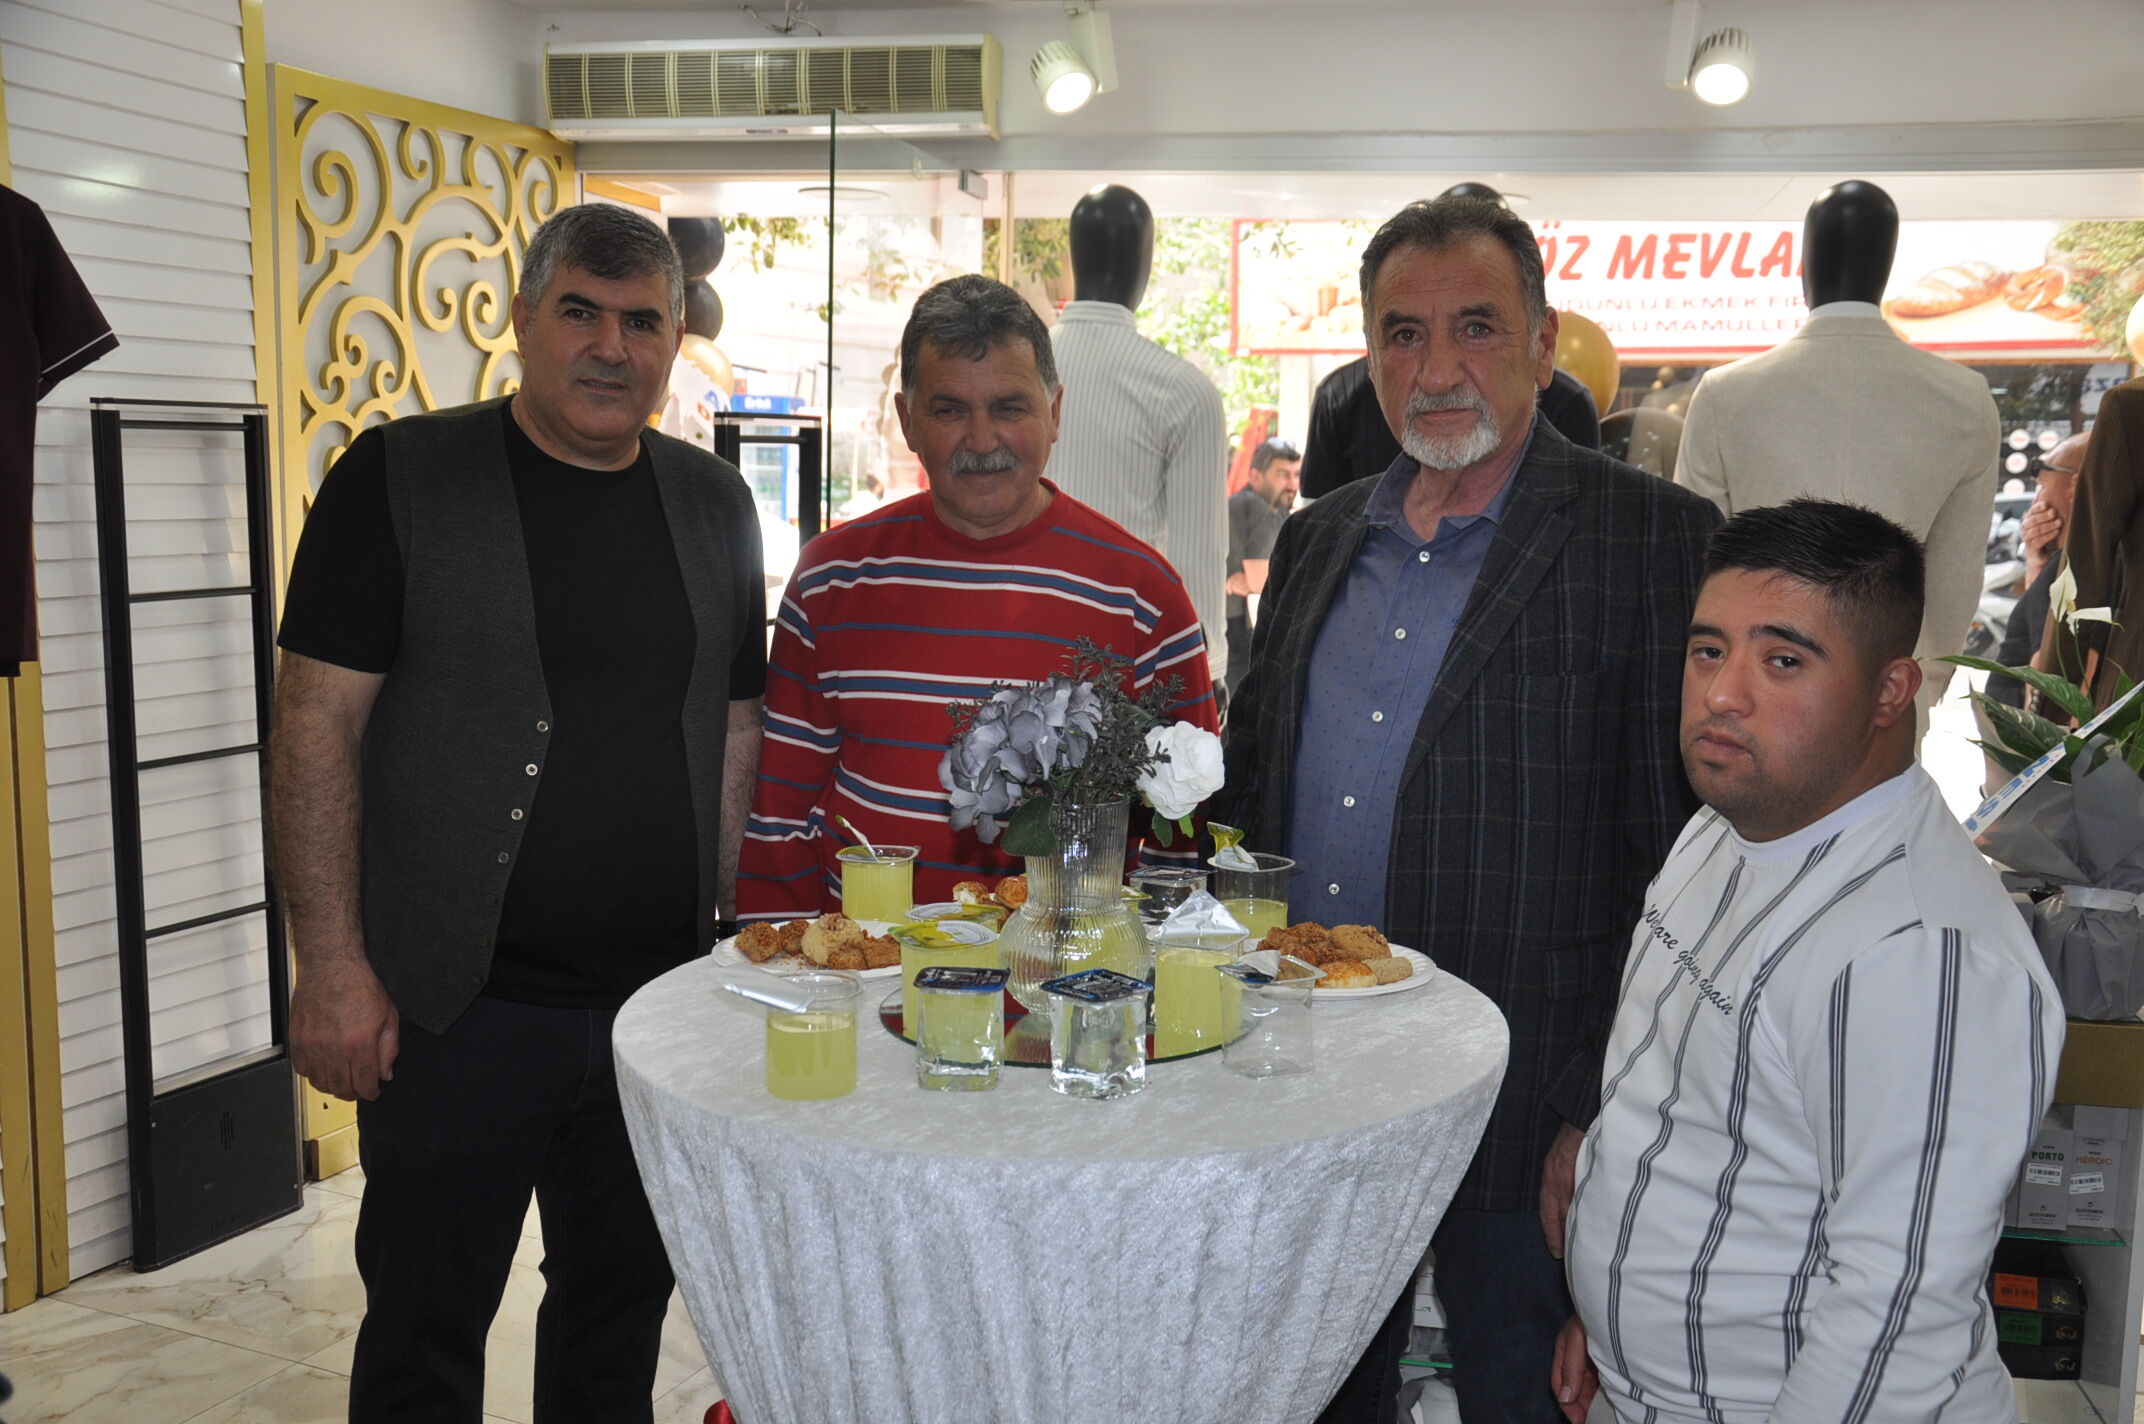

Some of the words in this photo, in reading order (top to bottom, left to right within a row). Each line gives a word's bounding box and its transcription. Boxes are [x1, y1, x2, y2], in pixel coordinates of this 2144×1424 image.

[1606, 231, 1803, 280] MEVLA
[1665, 296, 1757, 310] EKMEK
[1654, 926, 1678, 950] are
[1673, 950, 1701, 986] going
[1699, 978, 1733, 1015] again
[2031, 1151, 2065, 1162] PORTO
[2075, 1156, 2113, 1167] HEROIC
